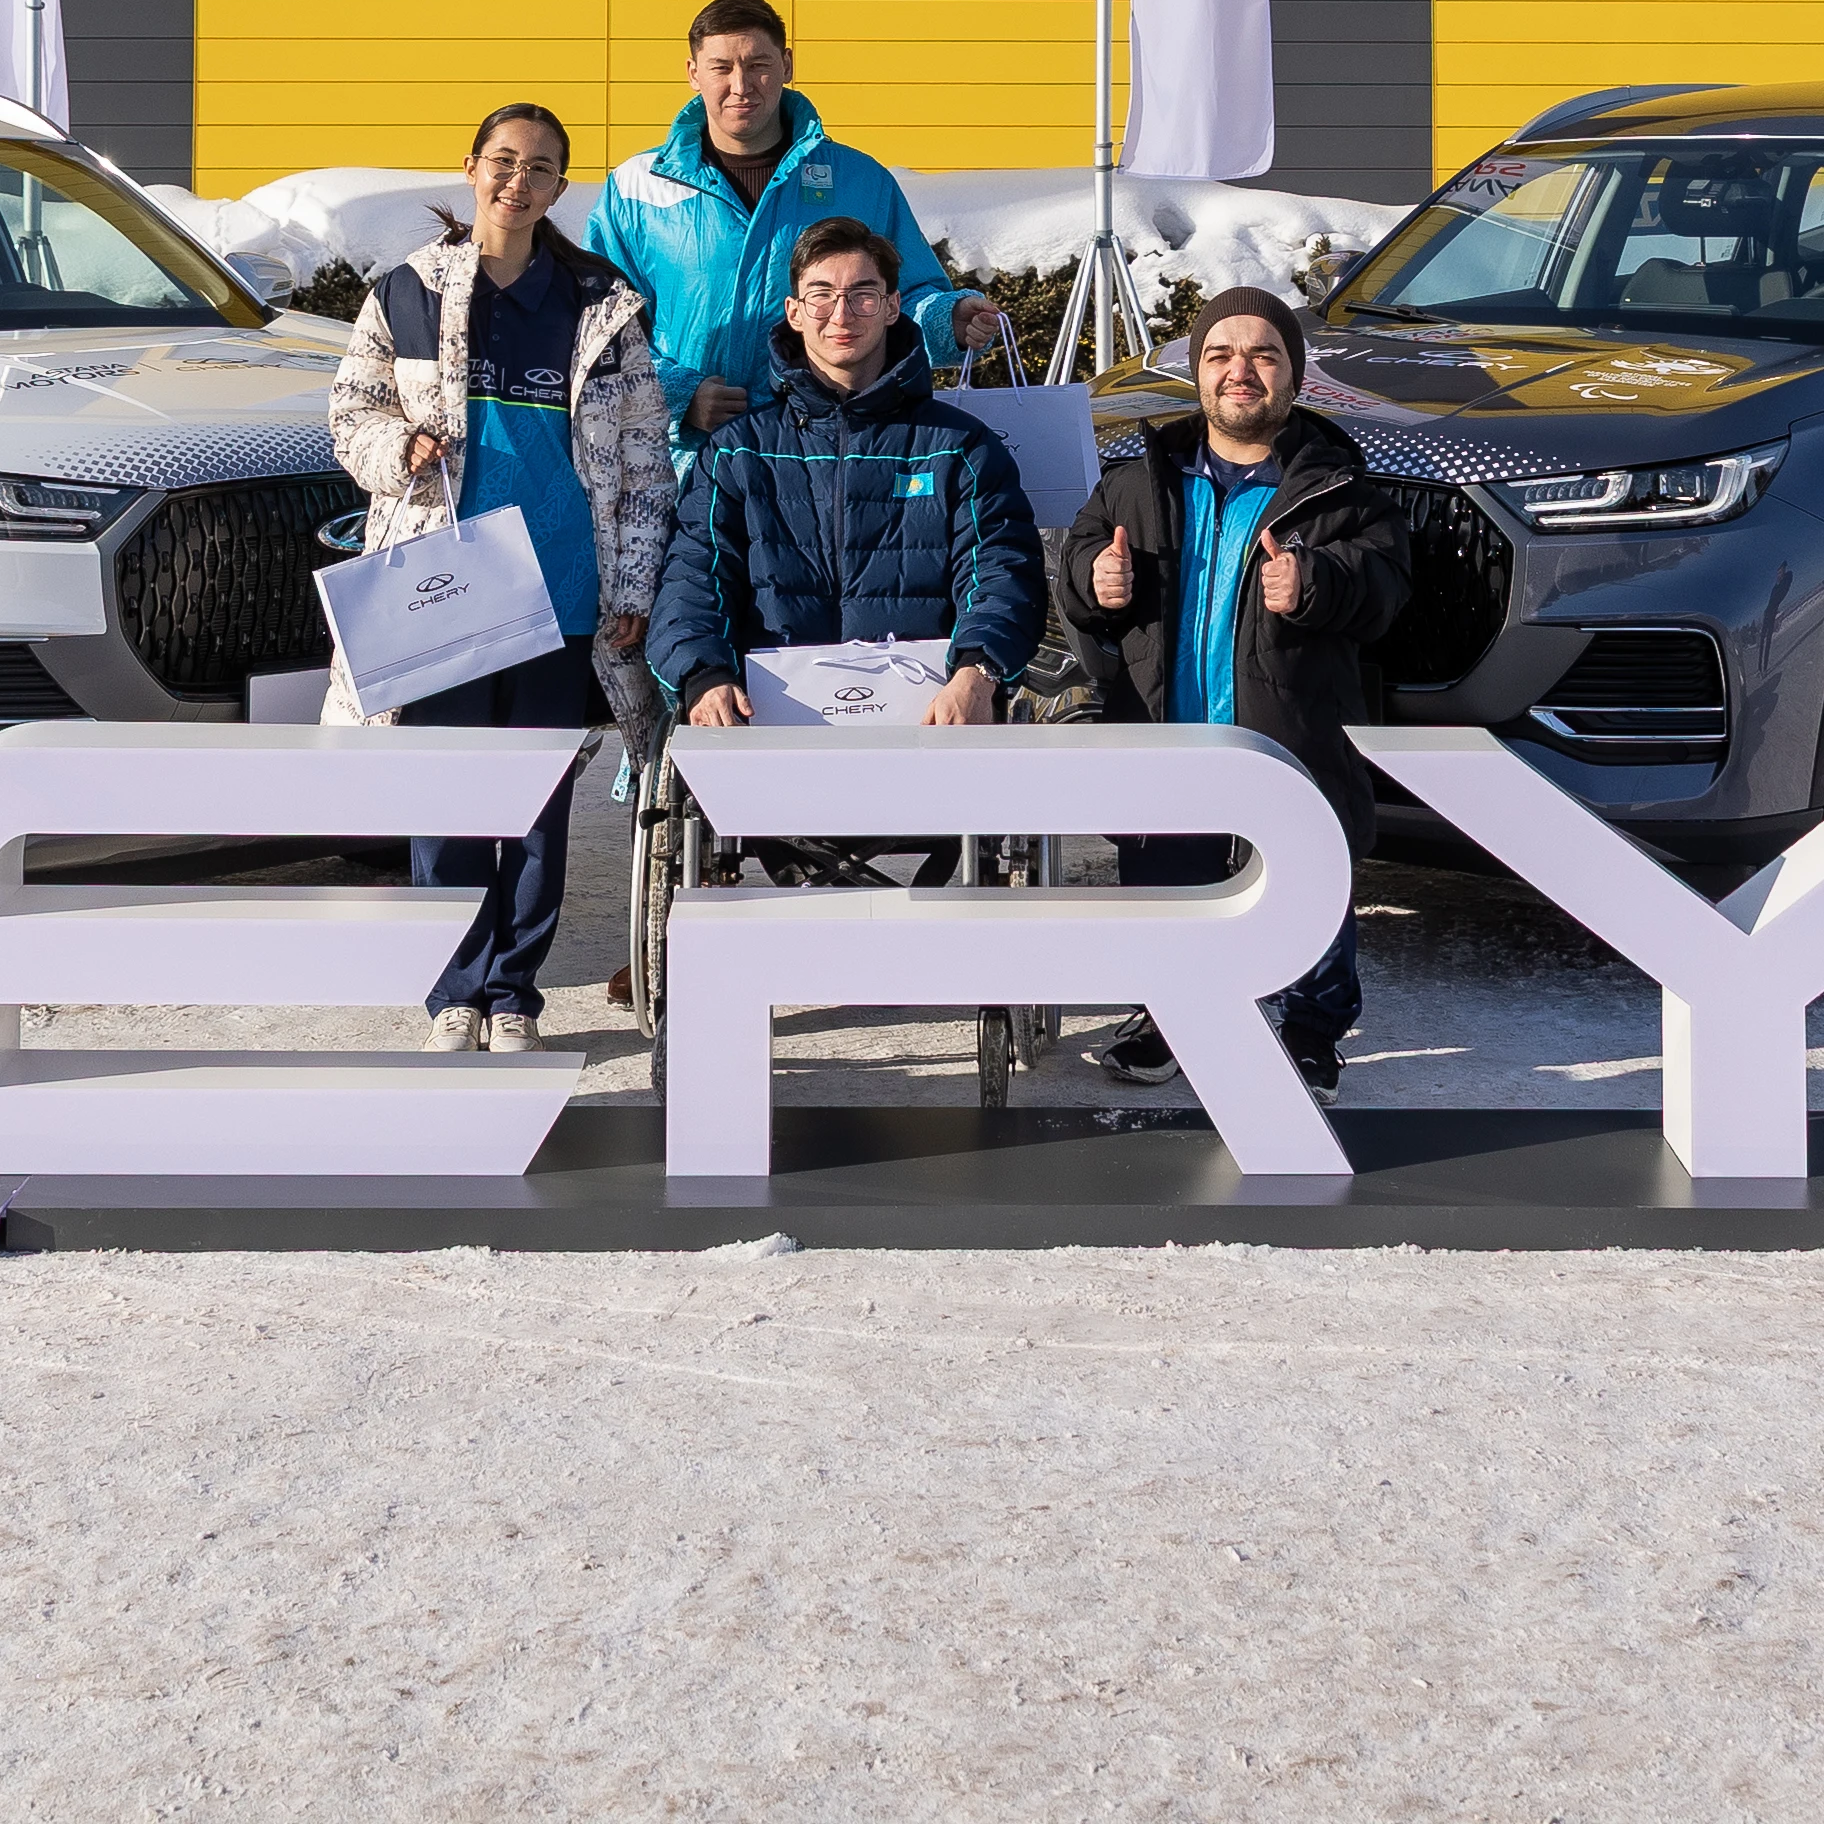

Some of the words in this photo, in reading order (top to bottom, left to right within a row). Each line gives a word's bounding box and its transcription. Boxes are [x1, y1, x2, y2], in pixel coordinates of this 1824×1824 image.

[1366, 356, 1528, 371] CHERY
[408, 583, 470, 611] CHERY
[822, 703, 887, 716] CHERY
